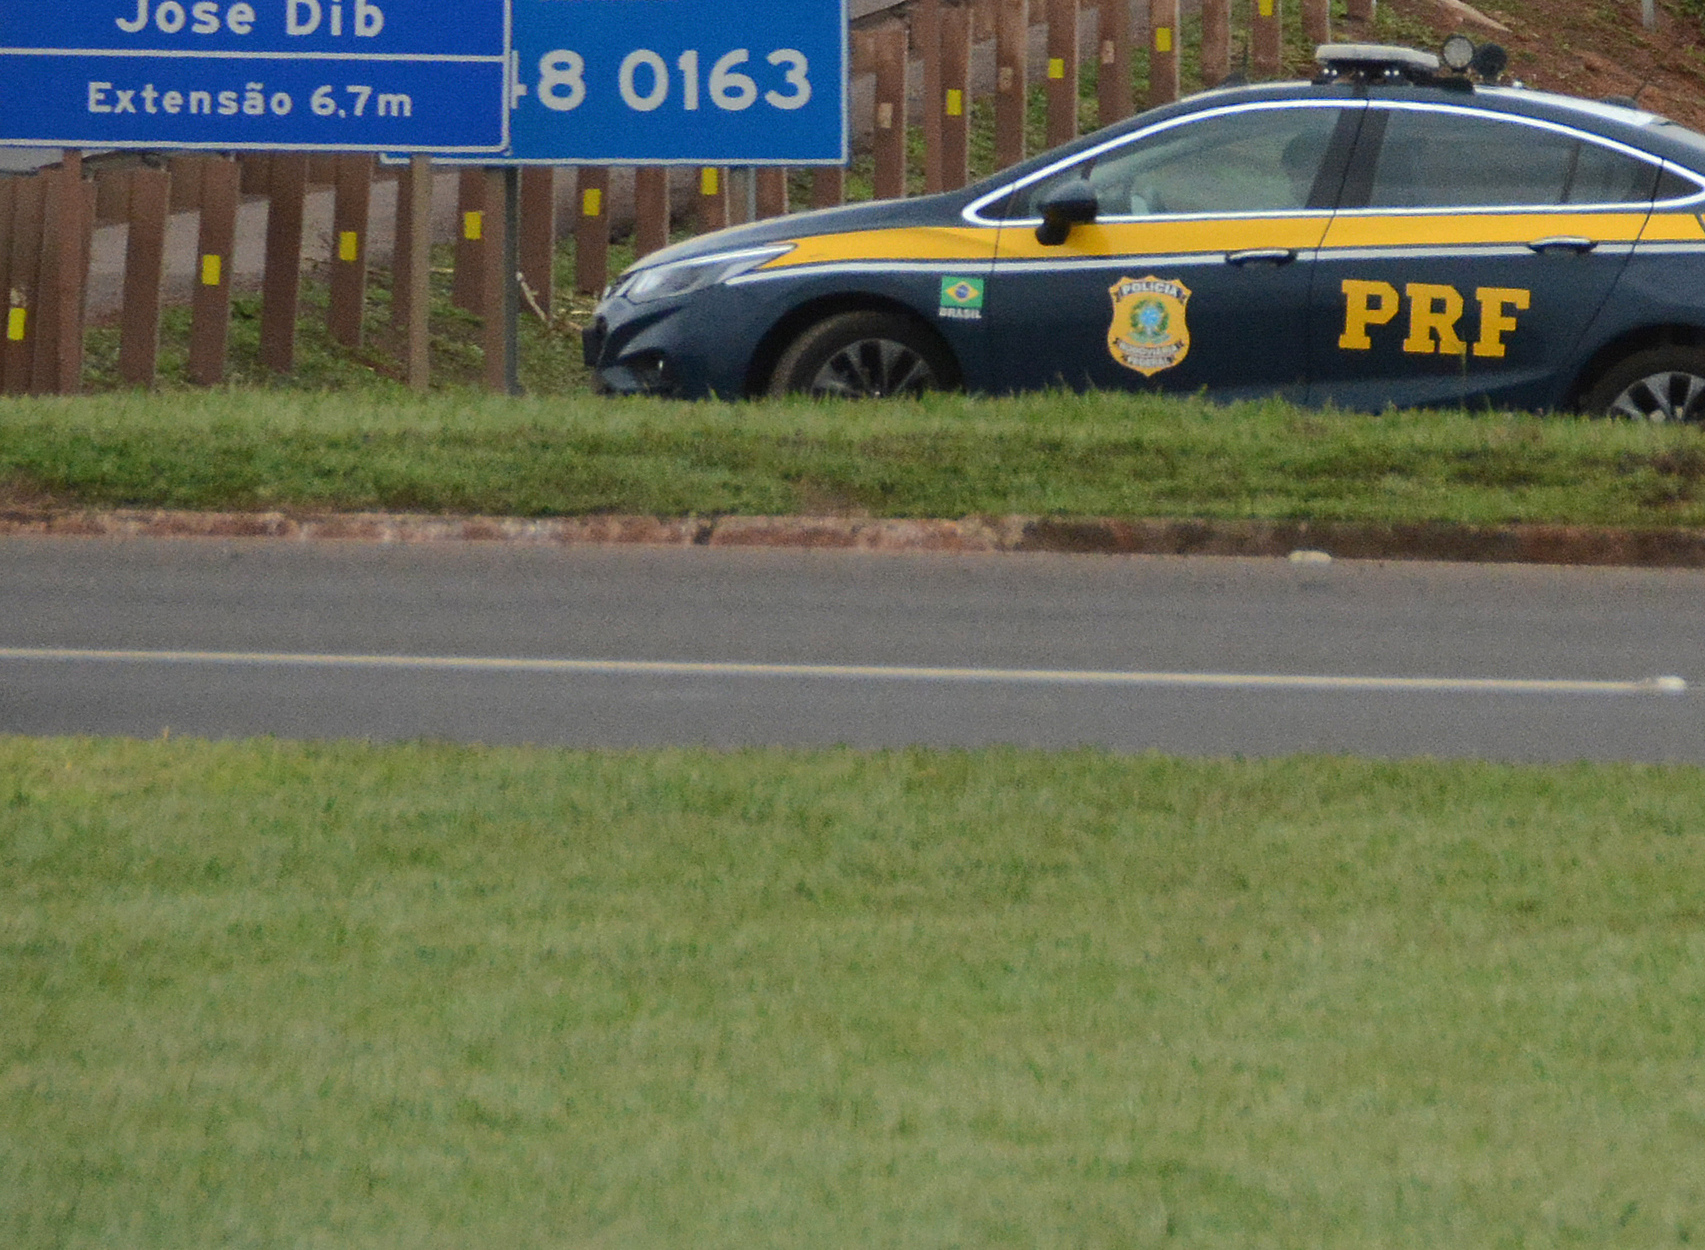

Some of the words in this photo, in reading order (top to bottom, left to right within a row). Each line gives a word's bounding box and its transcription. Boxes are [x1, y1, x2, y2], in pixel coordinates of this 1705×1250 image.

[87, 81, 293, 116] Extensão
[618, 48, 812, 112] 0163
[938, 306, 983, 319] BRASIL
[1338, 279, 1531, 358] PRF
